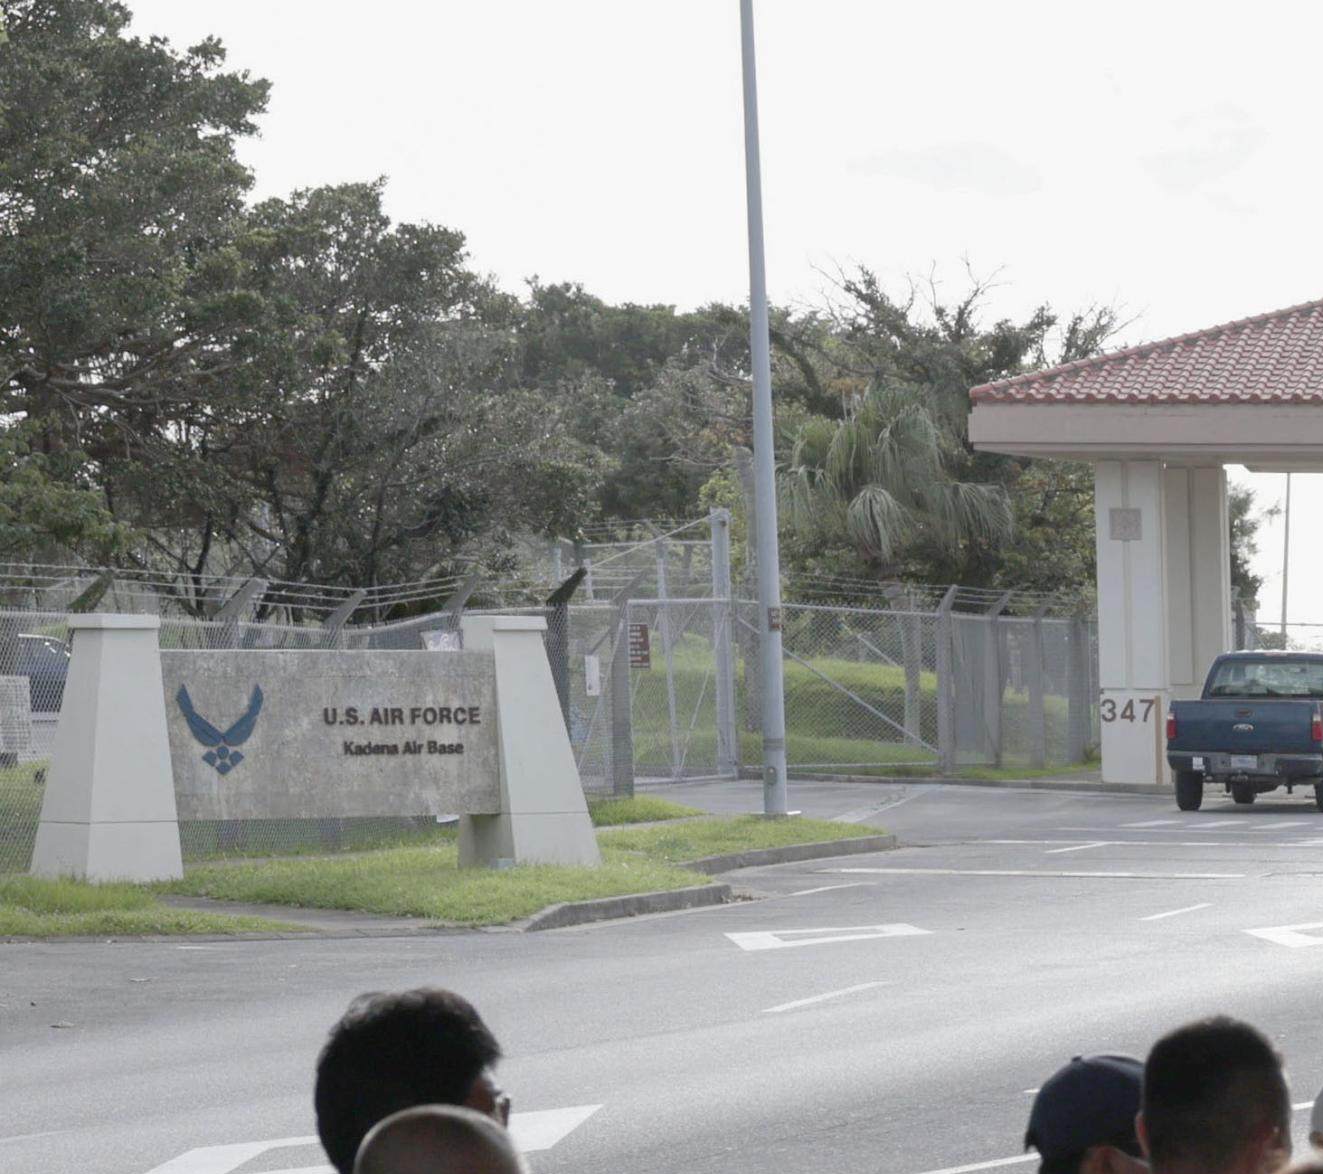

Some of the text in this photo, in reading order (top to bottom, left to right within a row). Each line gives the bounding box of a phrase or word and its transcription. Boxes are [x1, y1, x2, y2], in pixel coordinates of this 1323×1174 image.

[323, 706, 481, 726] U.S. AIR FORCE
[1101, 699, 1155, 723] 347
[343, 740, 464, 756] Kadena Air Base
